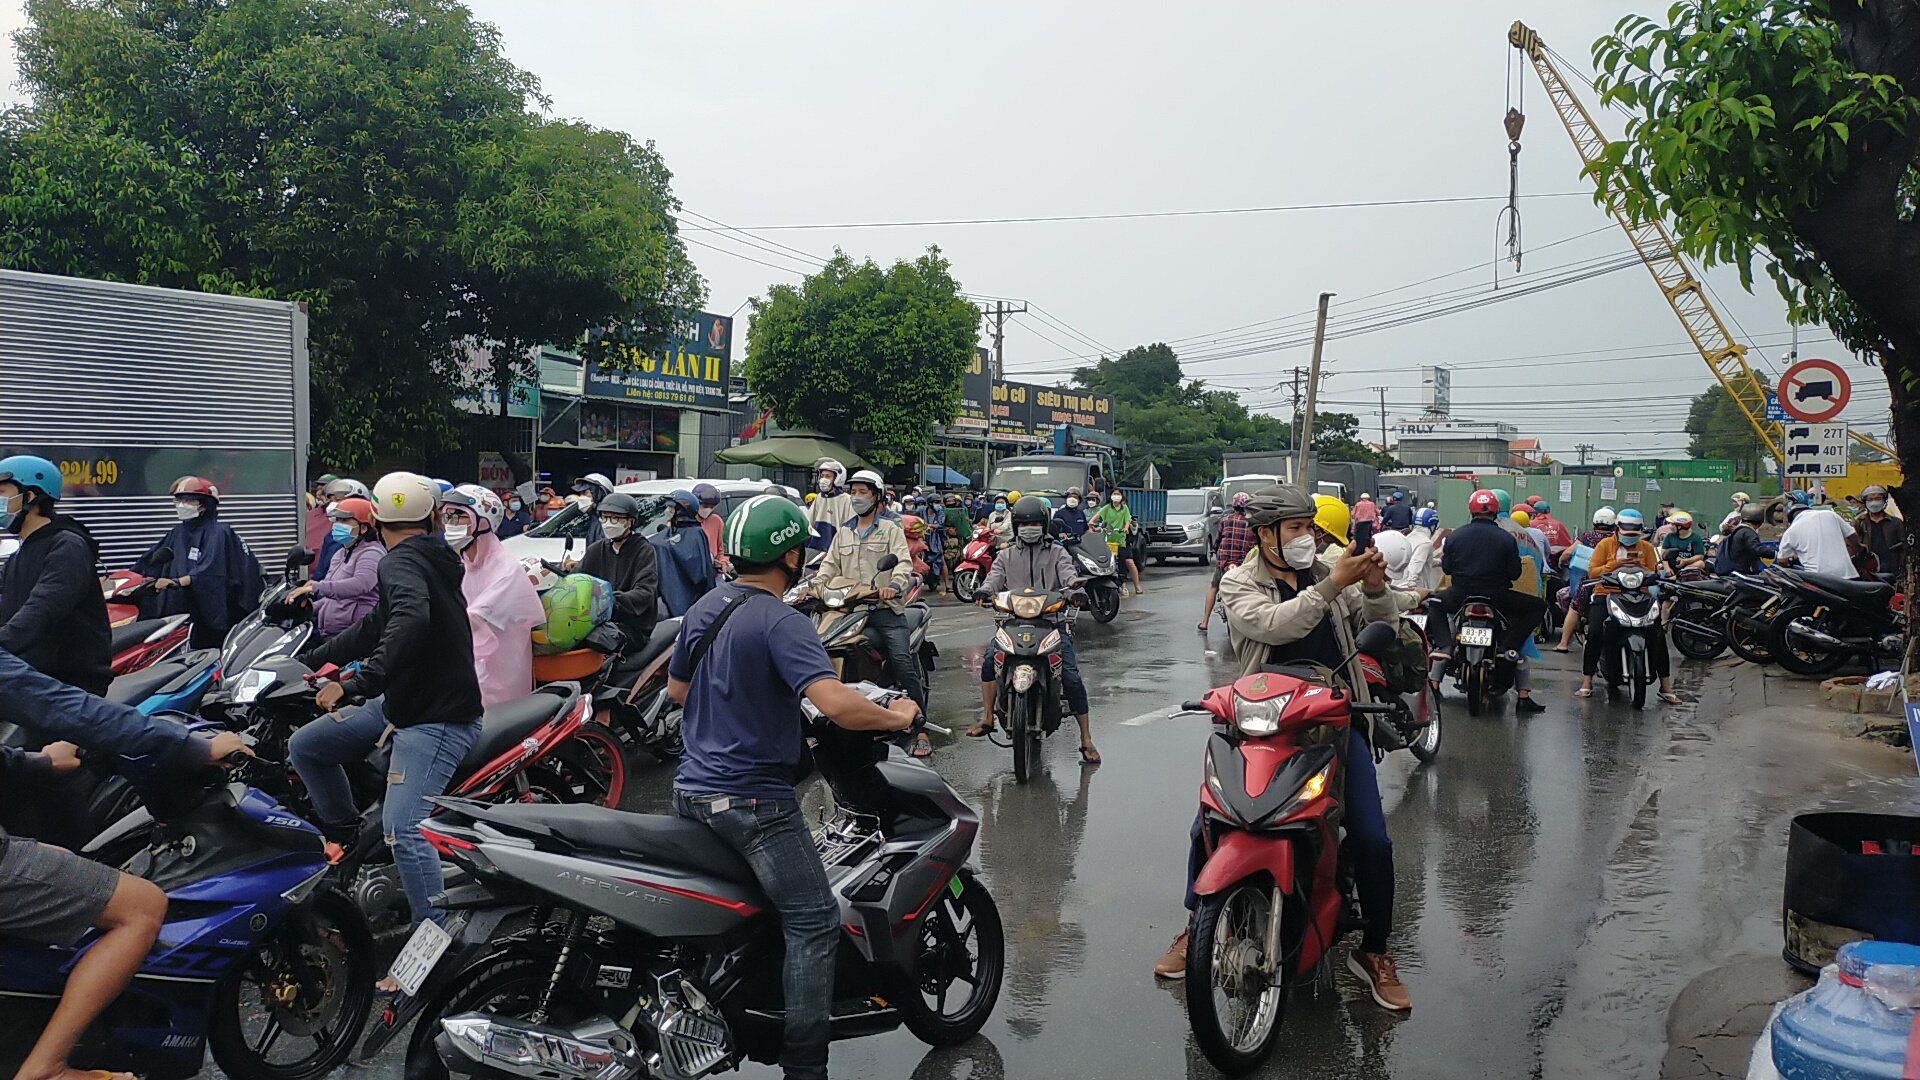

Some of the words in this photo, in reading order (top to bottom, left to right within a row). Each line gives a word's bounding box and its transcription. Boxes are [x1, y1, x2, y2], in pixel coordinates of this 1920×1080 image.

[703, 356, 720, 382] II
[655, 391, 669, 400] 0813
[1037, 391, 1060, 408] SIÊU
[1063, 395, 1078, 412] THỊ
[1823, 428, 1844, 439] 27T
[1822, 445, 1844, 456] 40T
[481, 464, 511, 480] BÚN
[1823, 464, 1844, 475] 45T
[769, 520, 801, 546] Grab
[1465, 628, 1487, 637] 83-P3
[264, 815, 301, 828] 150
[161, 1034, 201, 1048] AMAHA
